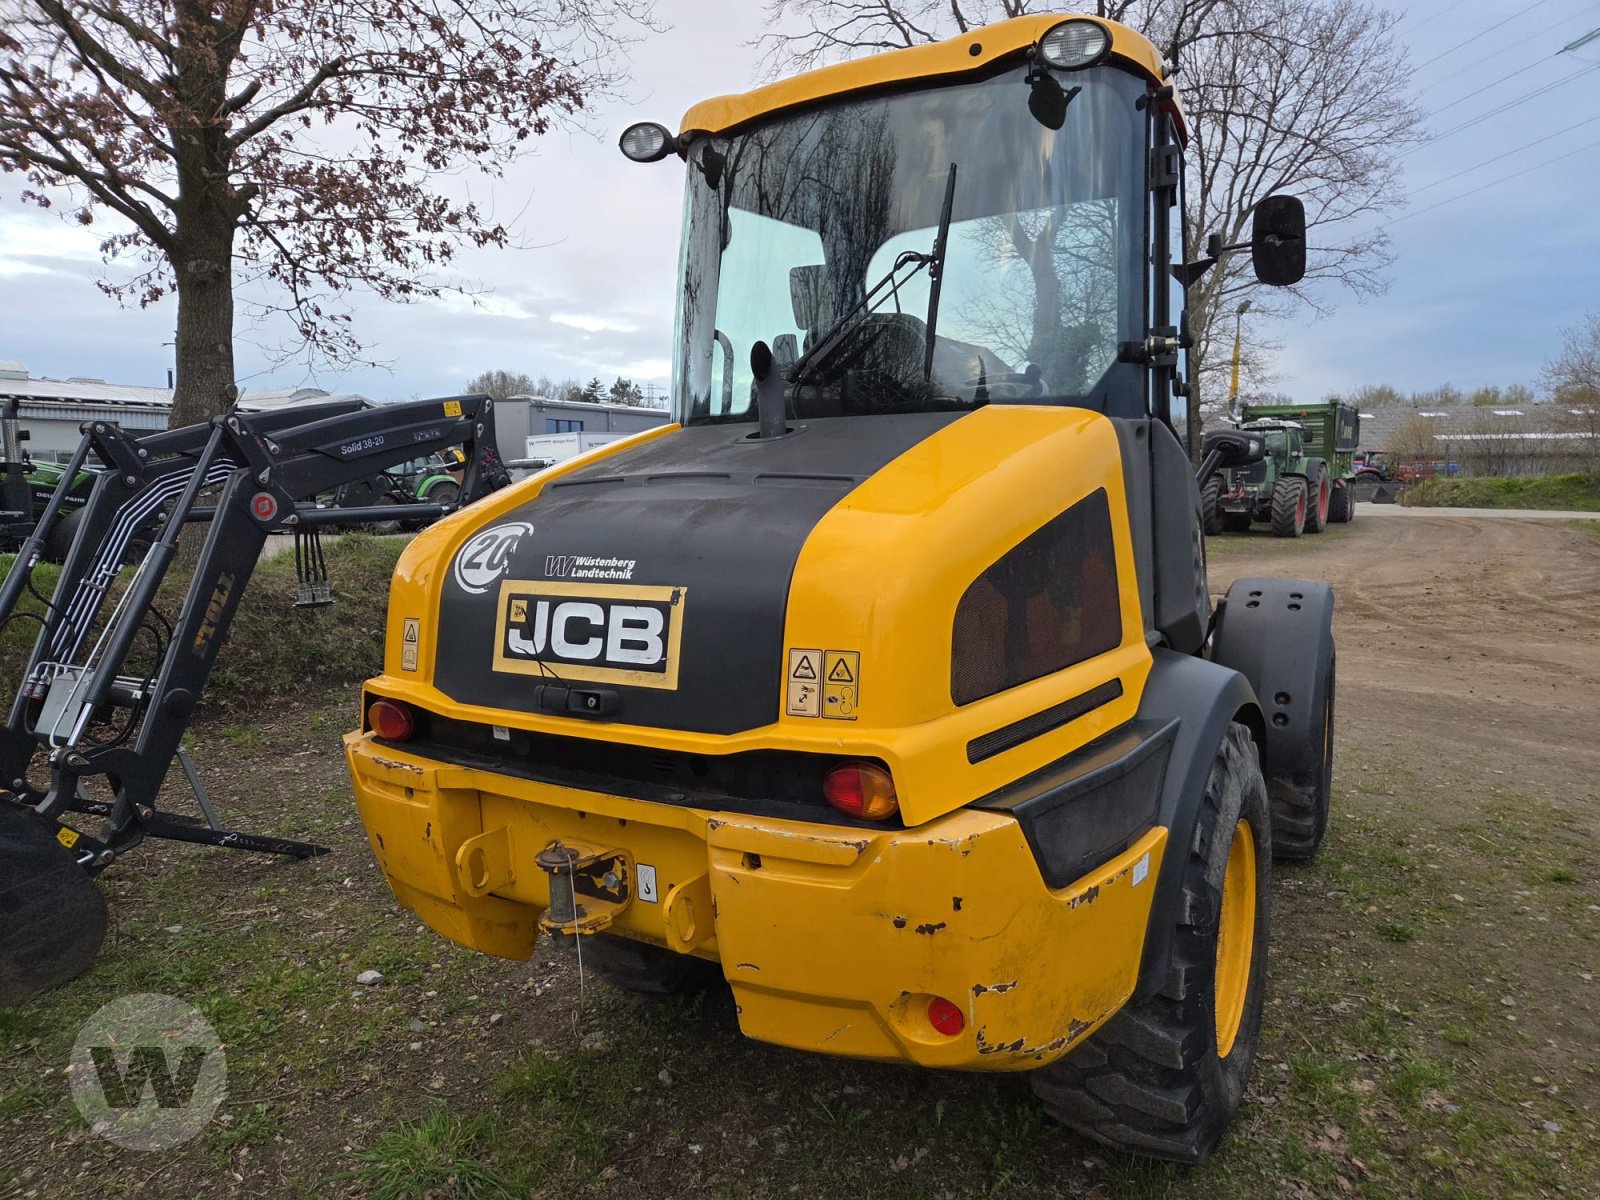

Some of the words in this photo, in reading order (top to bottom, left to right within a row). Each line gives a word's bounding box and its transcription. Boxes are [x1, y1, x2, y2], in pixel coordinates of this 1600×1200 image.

[341, 442, 362, 455] Solid
[363, 435, 384, 449] 38-20
[463, 534, 517, 571] 20
[575, 556, 636, 569] Wüstenberg
[570, 567, 633, 580] Landtechnik
[508, 601, 664, 665] JCB
